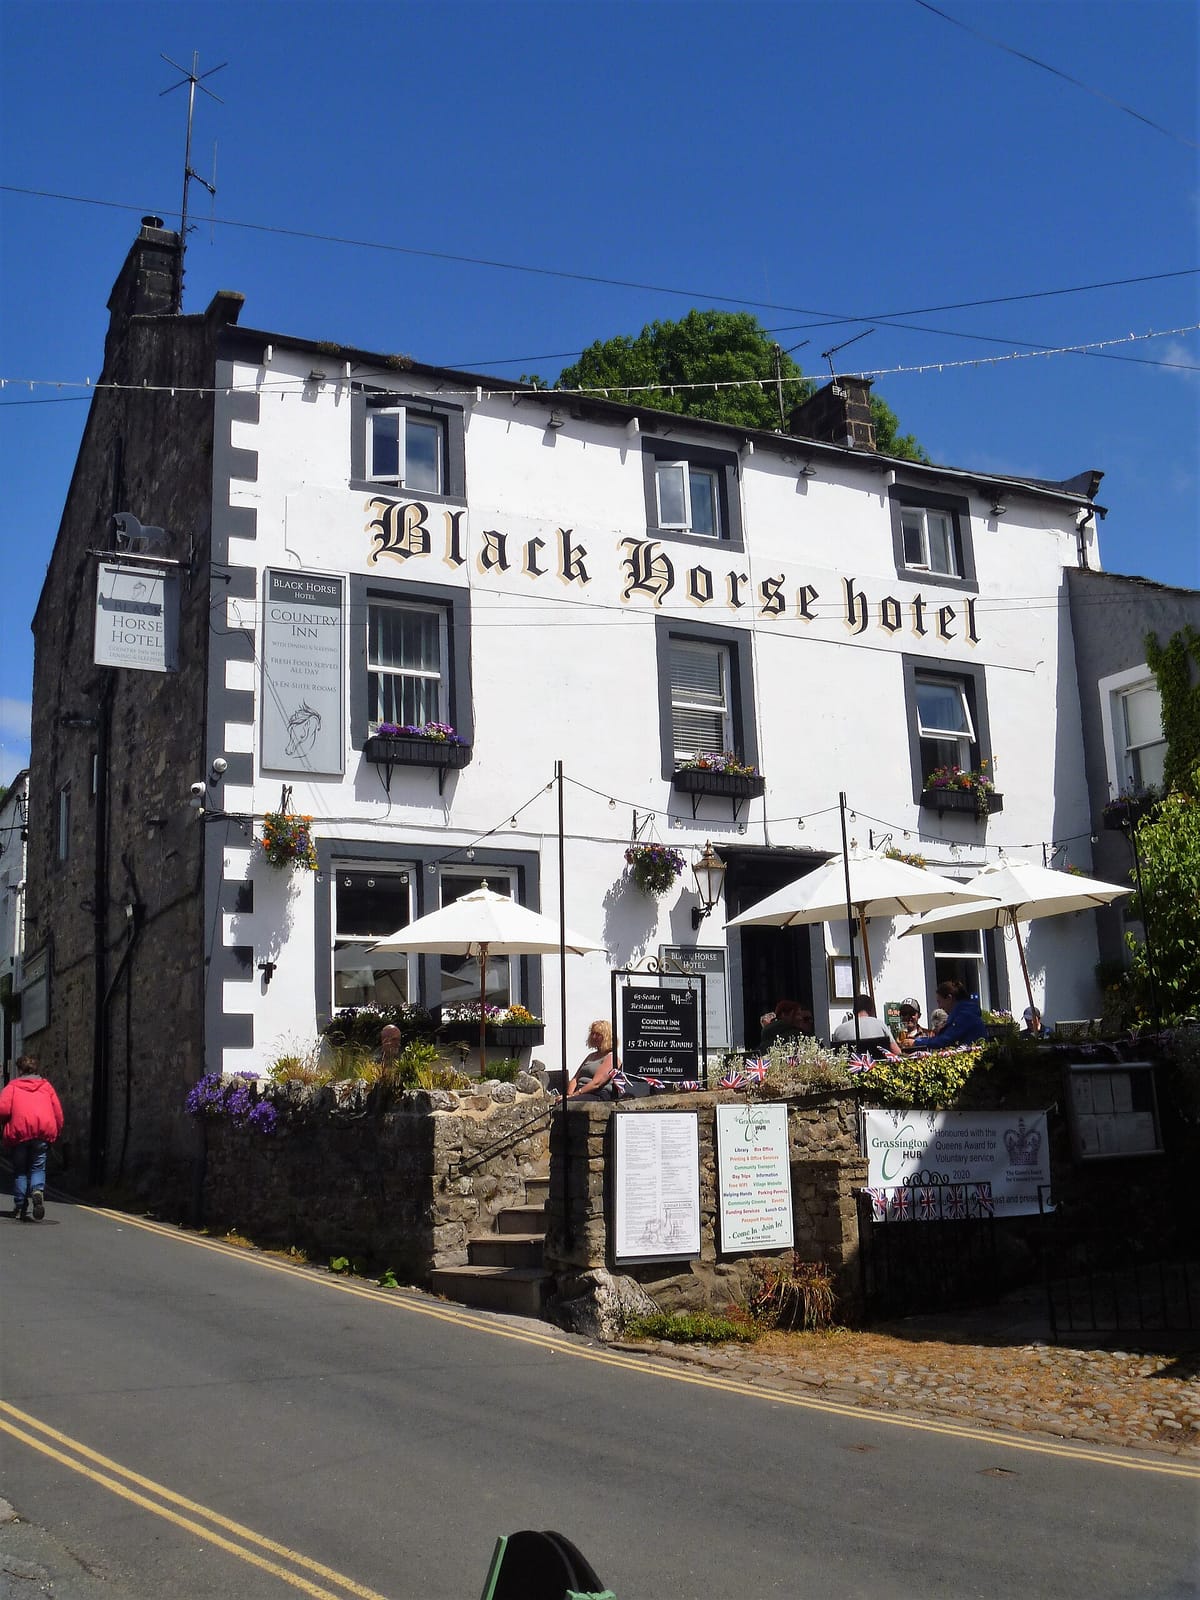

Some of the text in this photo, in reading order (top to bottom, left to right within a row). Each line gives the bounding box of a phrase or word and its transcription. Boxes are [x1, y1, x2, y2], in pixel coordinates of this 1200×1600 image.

[366, 496, 982, 647] Black Horse hotel
[273, 578, 337, 595] BLACK HORSE
[294, 591, 317, 601] HOTEL
[270, 608, 338, 626] COUNTRY
[112, 615, 163, 633] HORSE
[292, 625, 318, 639] INN
[112, 630, 163, 648] HOTEL
[312, 684, 337, 692] ROOMS
[695, 952, 718, 961] HORSE
[630, 1003, 664, 1011] Restaurant
[628, 1040, 635, 1048] 15
[670, 1040, 694, 1048] Rooms
[649, 1056, 668, 1064] Lunch
[638, 1066, 663, 1075] Evening
[935, 1128, 997, 1138] Honoured with the
[871, 1137, 929, 1150] Grassington
[935, 1140, 997, 1151] Queens Award for
[902, 1151, 923, 1159] HUB
[935, 1153, 995, 1164] Voluntary service
[952, 1170, 971, 1180] 2020
[732, 1230, 750, 1240] Come
[751, 1227, 758, 1235] In
[761, 1223, 775, 1232] Join
[775, 1219, 783, 1229] In!
